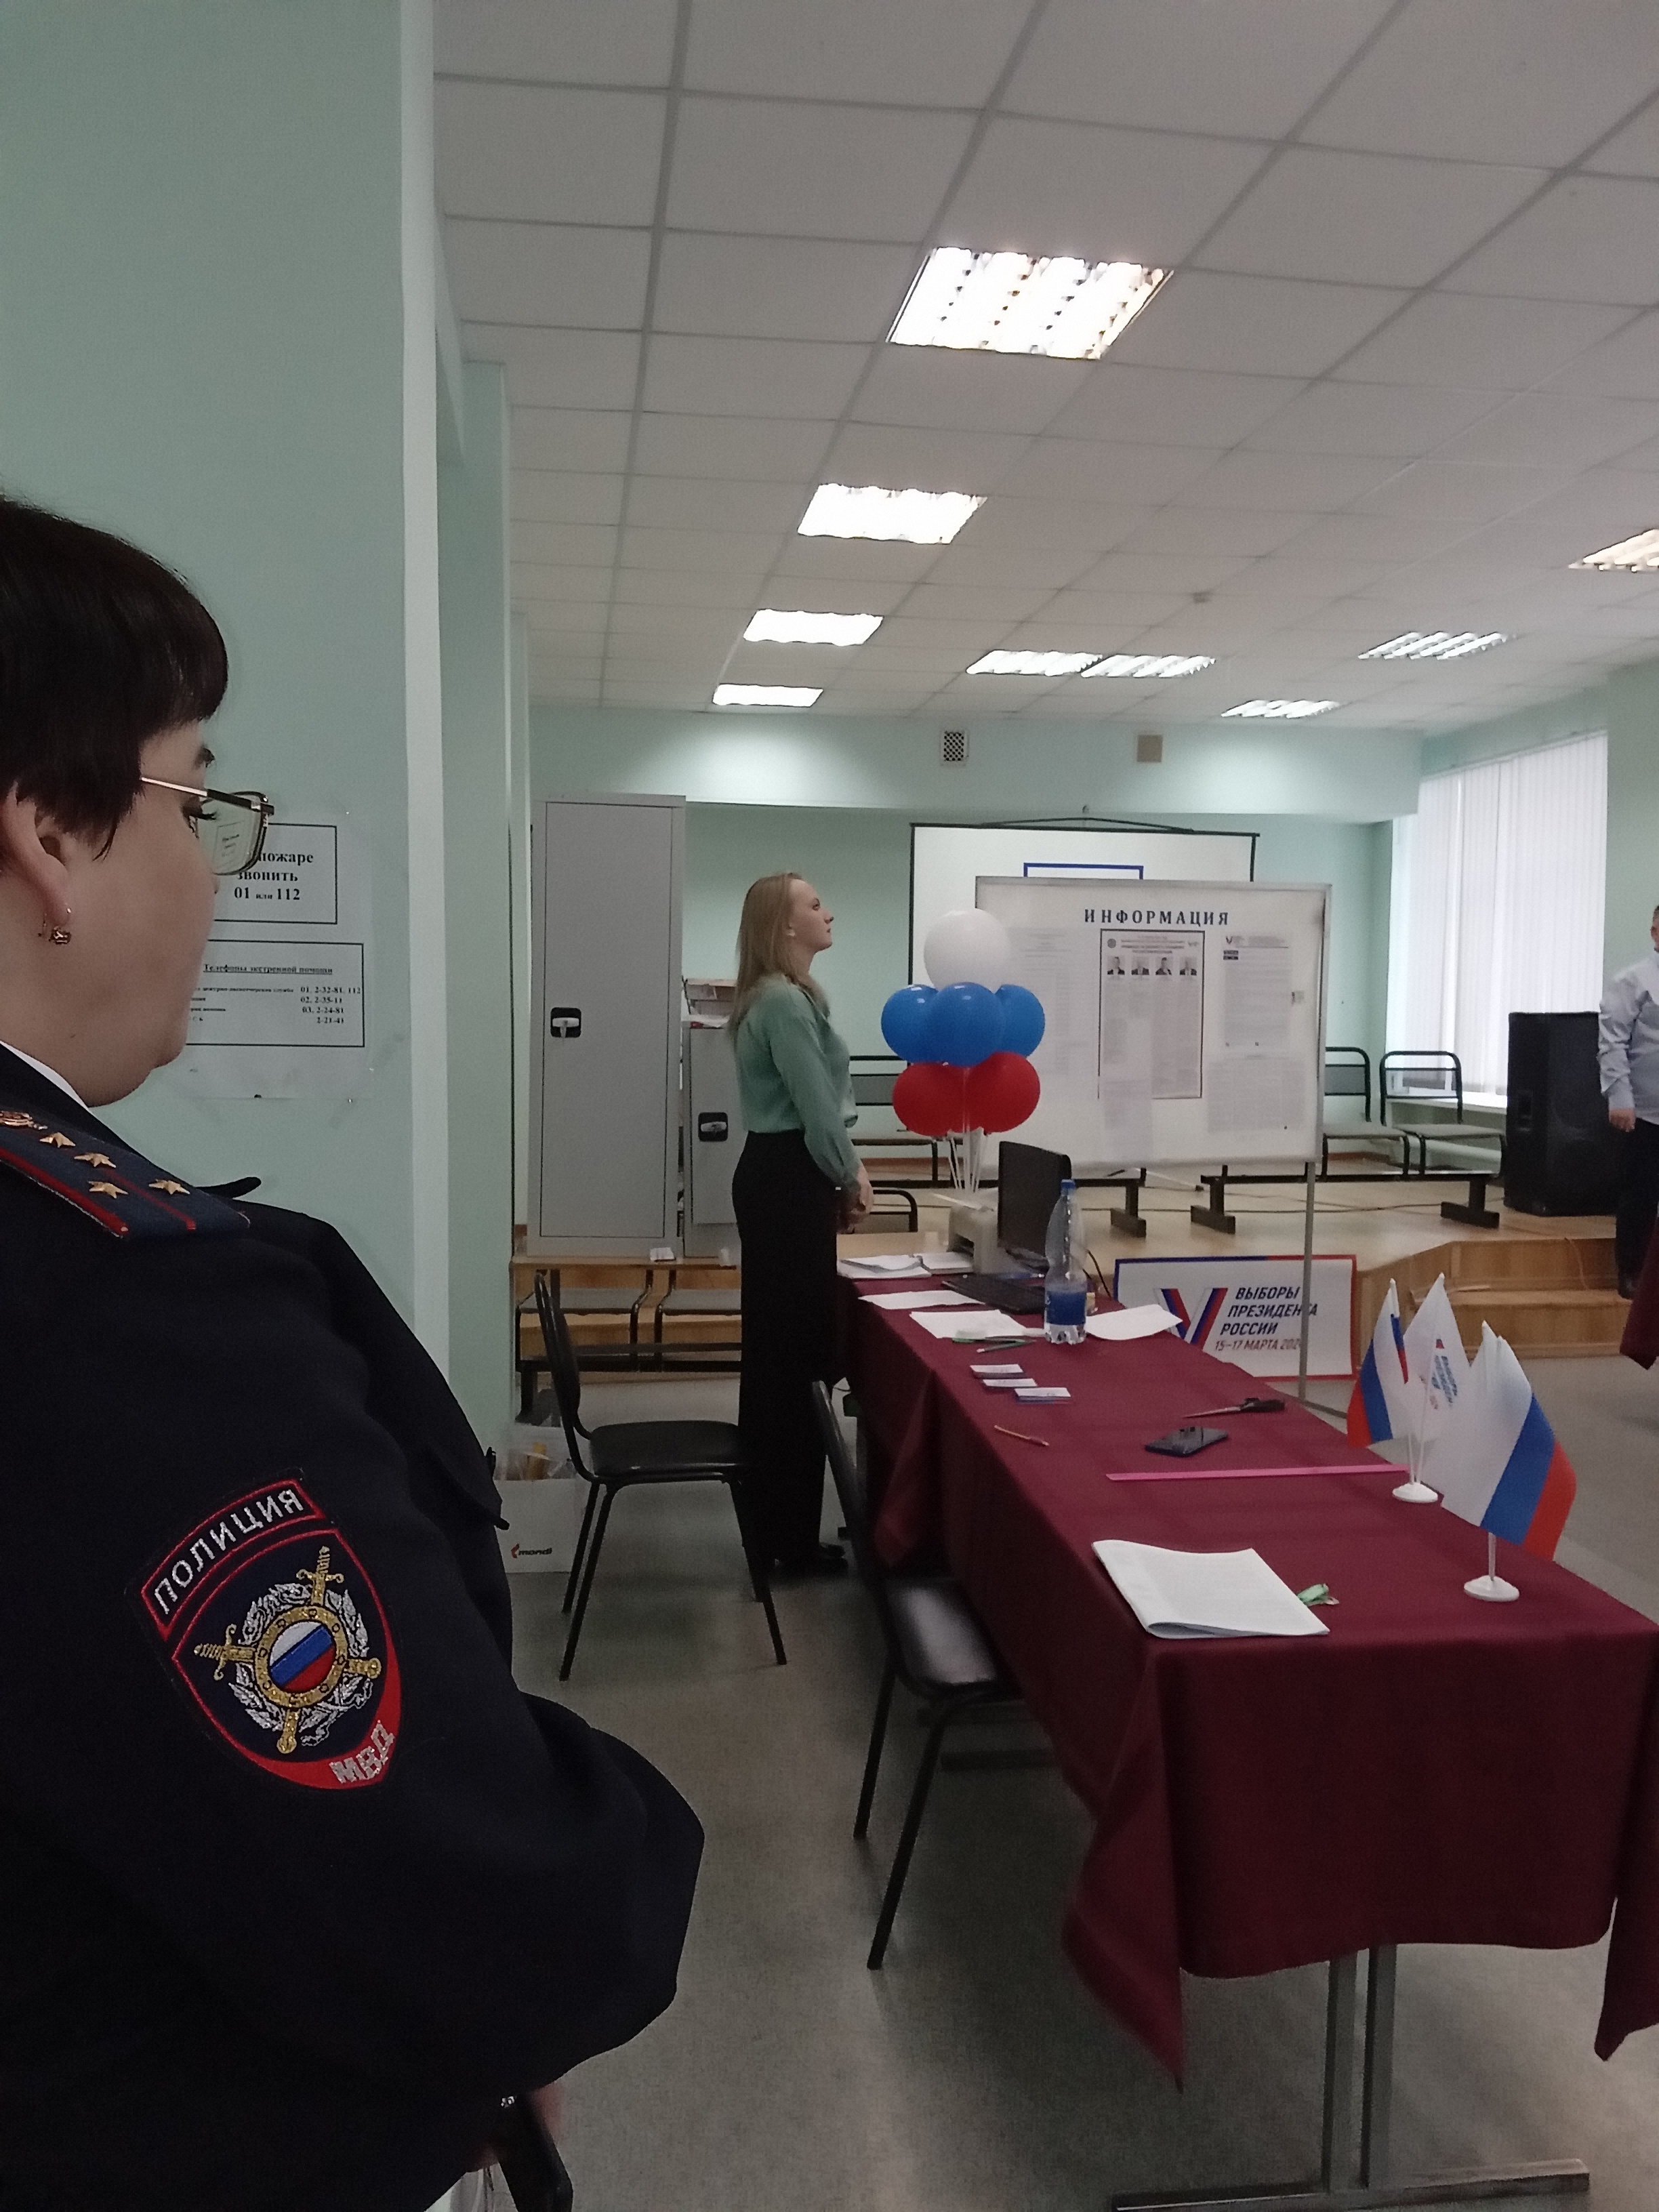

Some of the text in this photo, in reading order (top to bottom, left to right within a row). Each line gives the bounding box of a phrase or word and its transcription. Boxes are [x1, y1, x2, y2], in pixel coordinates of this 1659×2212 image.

[237, 871, 298, 882] звонить
[234, 886, 249, 899] 01
[277, 888, 300, 901] 112
[1084, 909, 1229, 926] ИНФОРМАЦИЯ
[1235, 1286, 1300, 1300] ВЫБОРЫ
[1220, 1322, 1279, 1336] РОССИИ
[1244, 1339, 1279, 1351] МАРТА
[155, 1489, 304, 1615] ПОЛИЦИЯ
[329, 1720, 395, 1784] МВД
